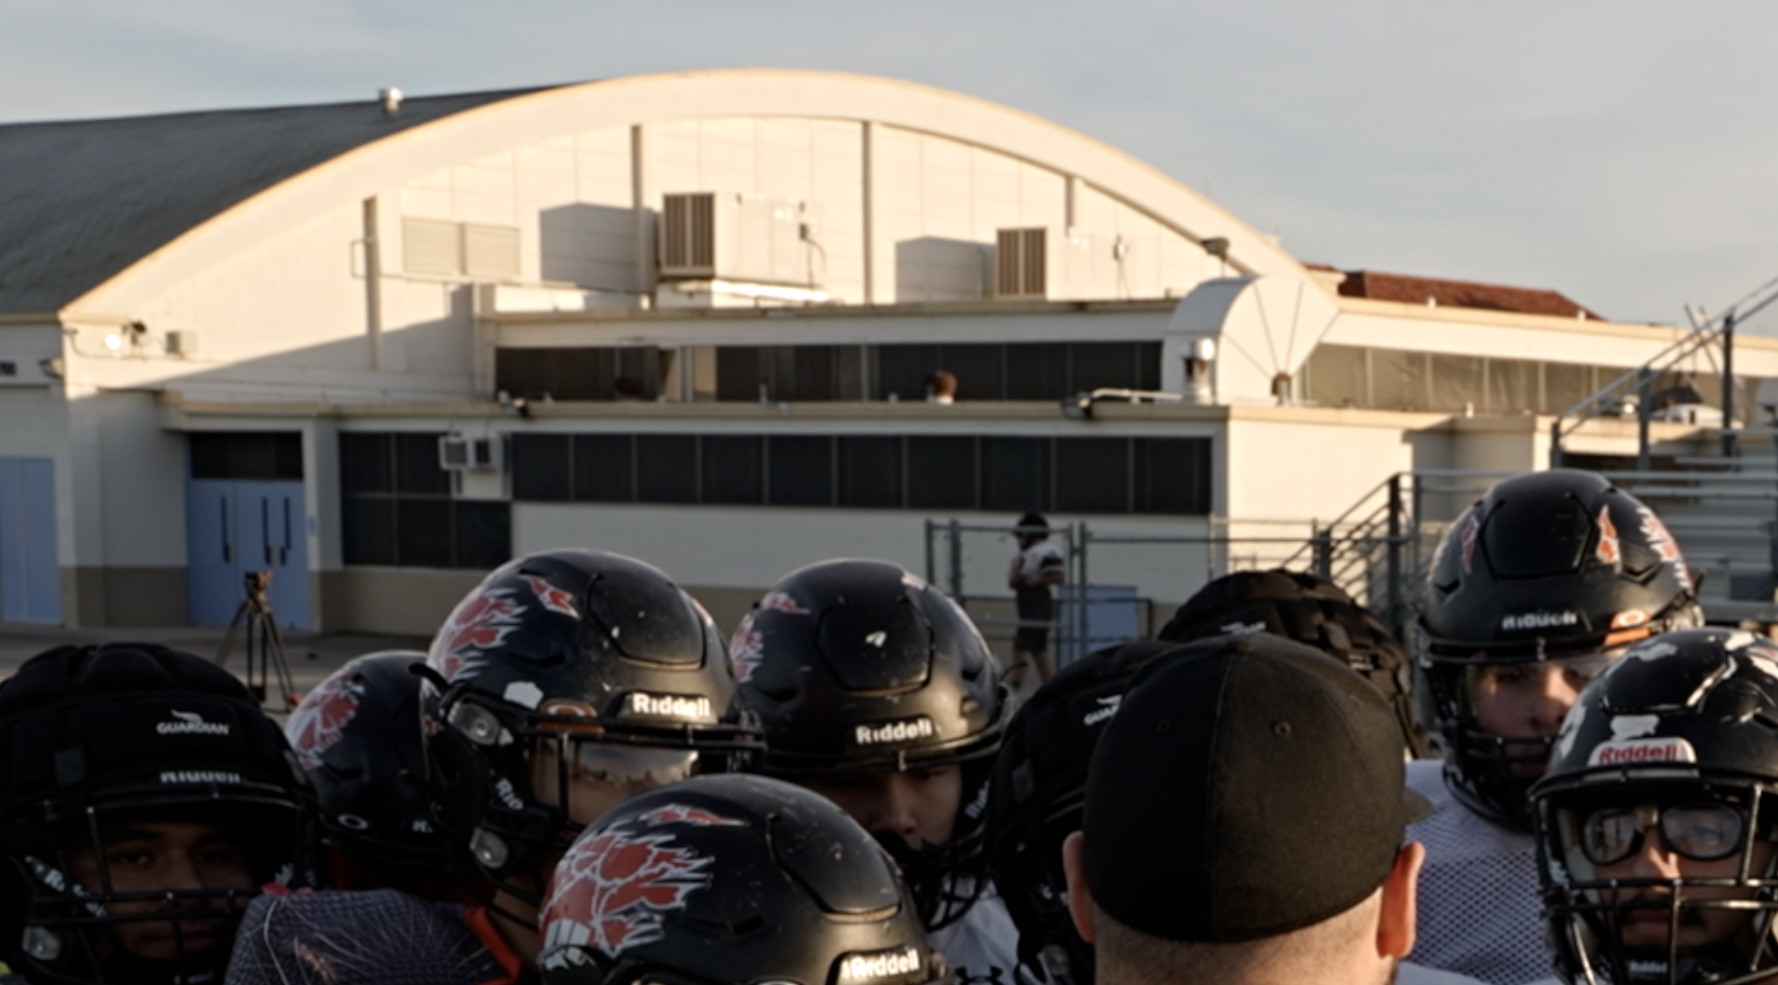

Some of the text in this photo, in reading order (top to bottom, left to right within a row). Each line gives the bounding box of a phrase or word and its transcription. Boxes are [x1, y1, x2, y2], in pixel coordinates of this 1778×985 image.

[632, 692, 711, 716] Riddell
[853, 717, 934, 746] Riddell
[1599, 743, 1677, 763] Riddell
[850, 948, 920, 978] Riddell
